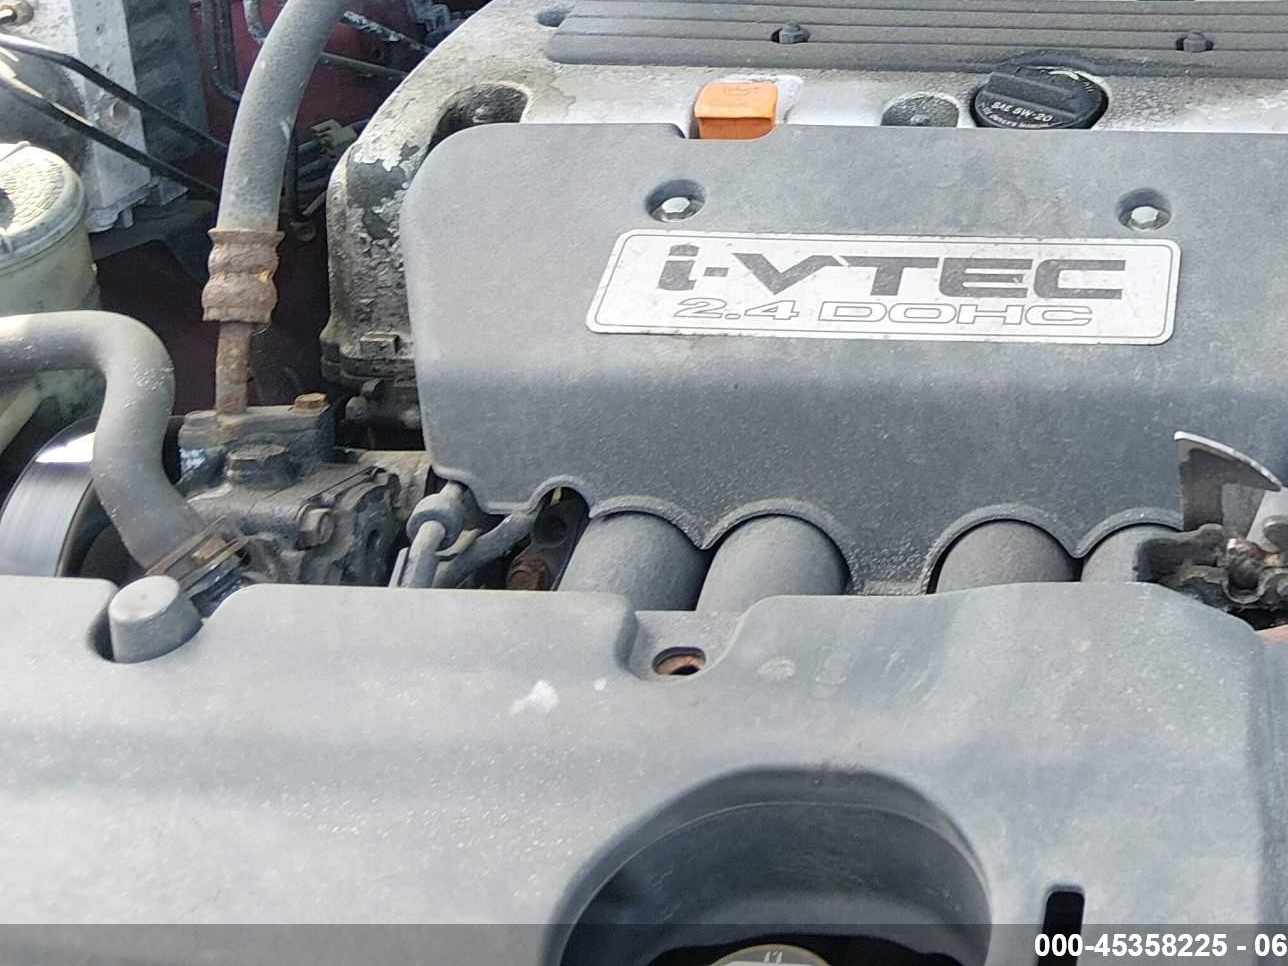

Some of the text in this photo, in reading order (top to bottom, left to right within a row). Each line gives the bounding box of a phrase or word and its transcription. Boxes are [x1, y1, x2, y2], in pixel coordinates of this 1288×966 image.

[991, 101, 1014, 112] SAE
[657, 244, 1126, 299] i-VTEC
[673, 297, 1093, 327] 2.4 DOHC
